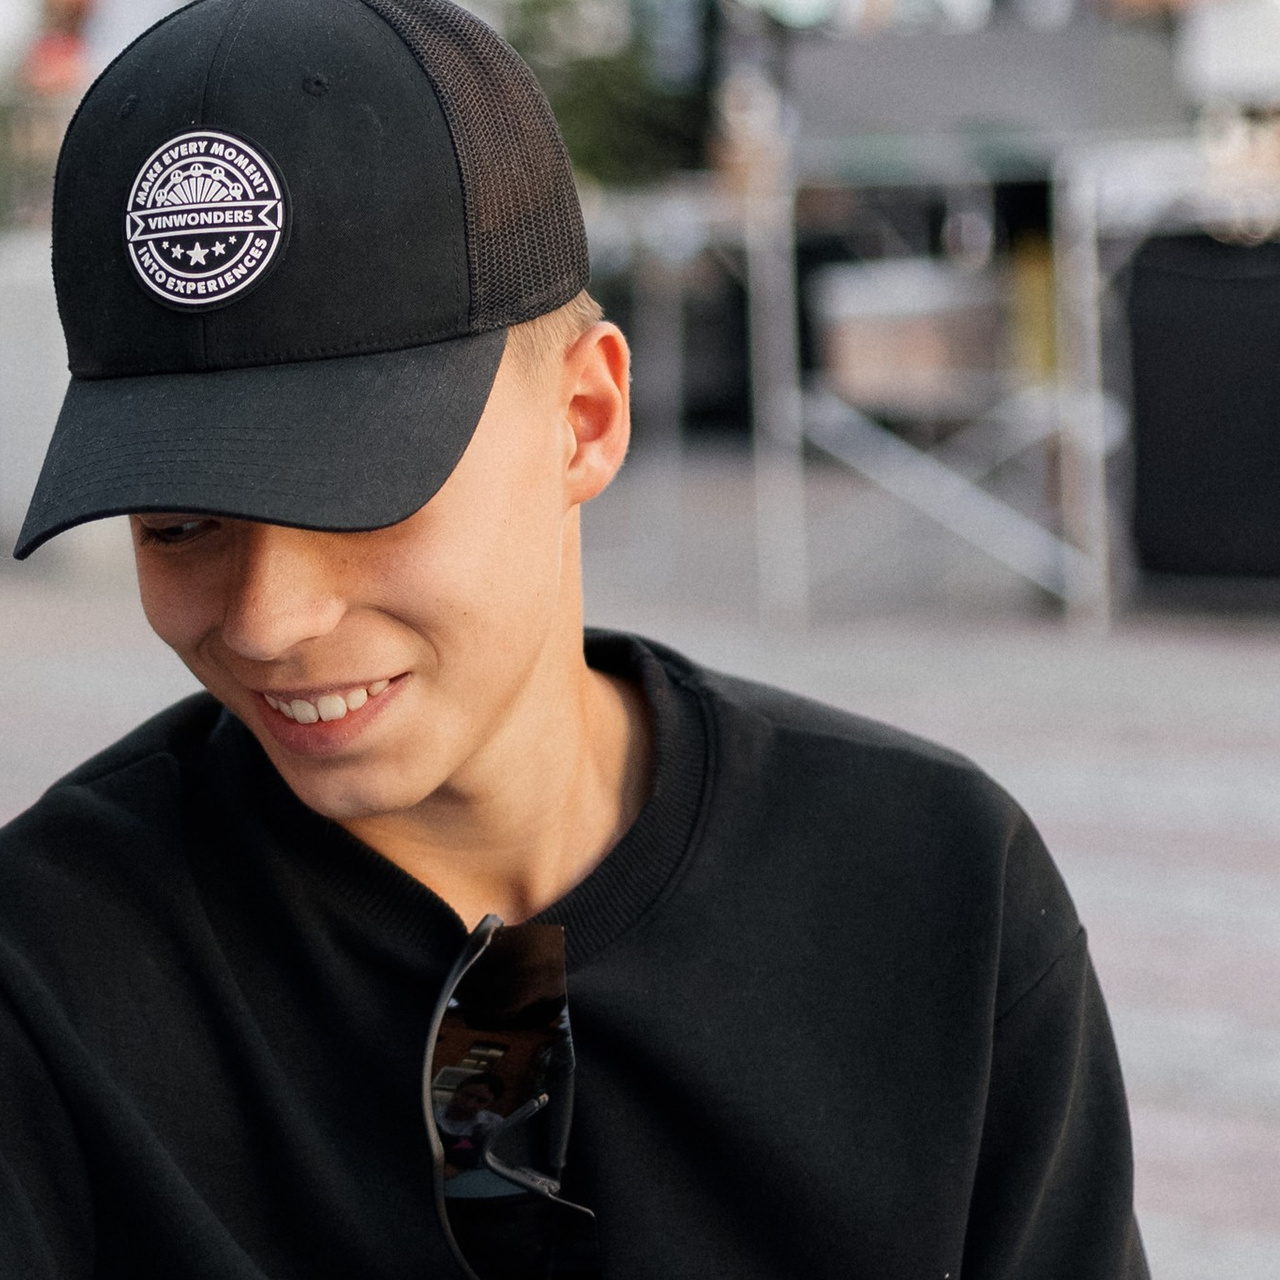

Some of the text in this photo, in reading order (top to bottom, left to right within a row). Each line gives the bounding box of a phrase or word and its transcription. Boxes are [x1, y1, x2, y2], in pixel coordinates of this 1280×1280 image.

[136, 141, 269, 205] MAKE EVERY MOMENT
[148, 210, 253, 230] VINWONDERS
[138, 237, 267, 294] INTO EXPERIENCES
